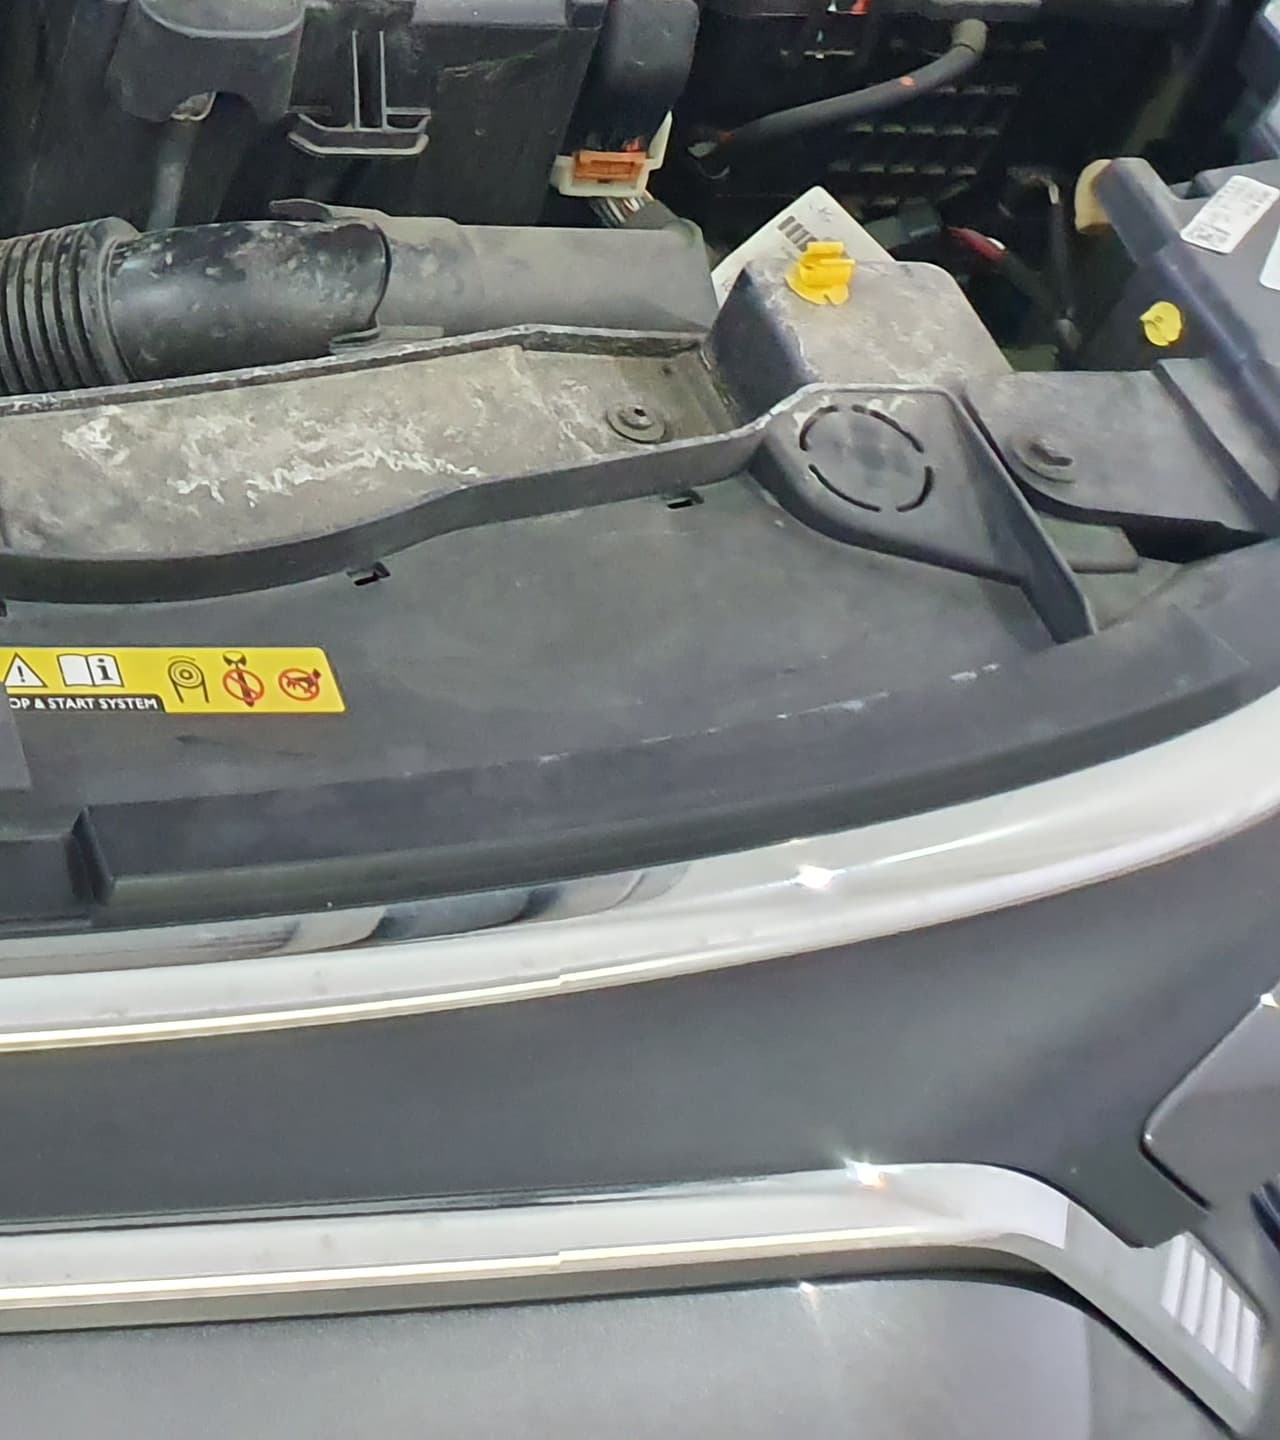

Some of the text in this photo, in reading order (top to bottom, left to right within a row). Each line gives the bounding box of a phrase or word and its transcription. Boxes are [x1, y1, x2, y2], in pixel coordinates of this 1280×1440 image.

[8, 697, 30, 710] OP
[47, 697, 95, 710] START
[97, 697, 158, 710] SYSTEM
